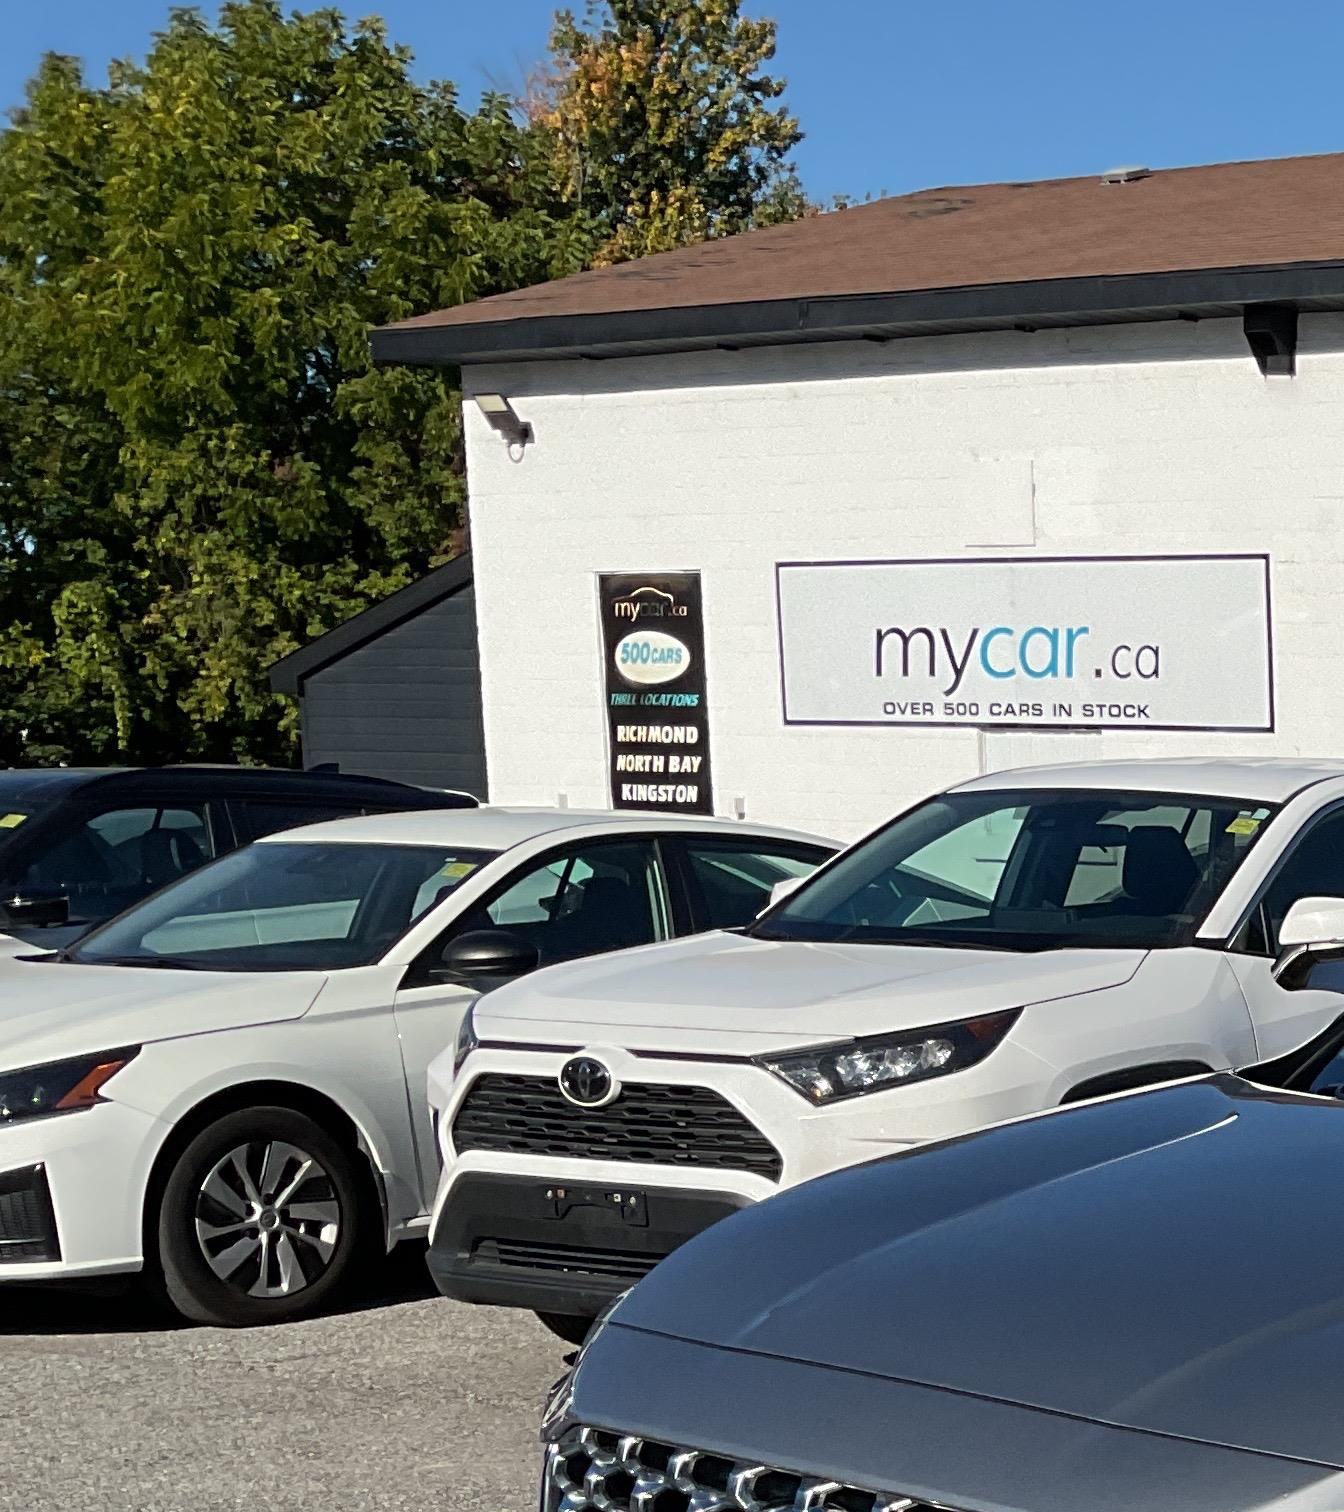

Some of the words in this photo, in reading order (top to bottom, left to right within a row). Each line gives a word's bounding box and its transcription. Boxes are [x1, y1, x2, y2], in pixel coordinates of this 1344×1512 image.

[874, 626, 1160, 697] mycar.ca
[640, 693, 699, 707] LOCATIONS
[883, 701, 934, 716] OVER
[943, 701, 980, 717] 500
[989, 702, 1043, 717] CARS
[1052, 703, 1072, 717] IN
[1082, 703, 1150, 718] STOCK
[617, 725, 698, 744] RICHMOND
[616, 754, 664, 772] NORTH
[668, 755, 702, 773] BAY
[621, 784, 698, 803] KINGSTON
